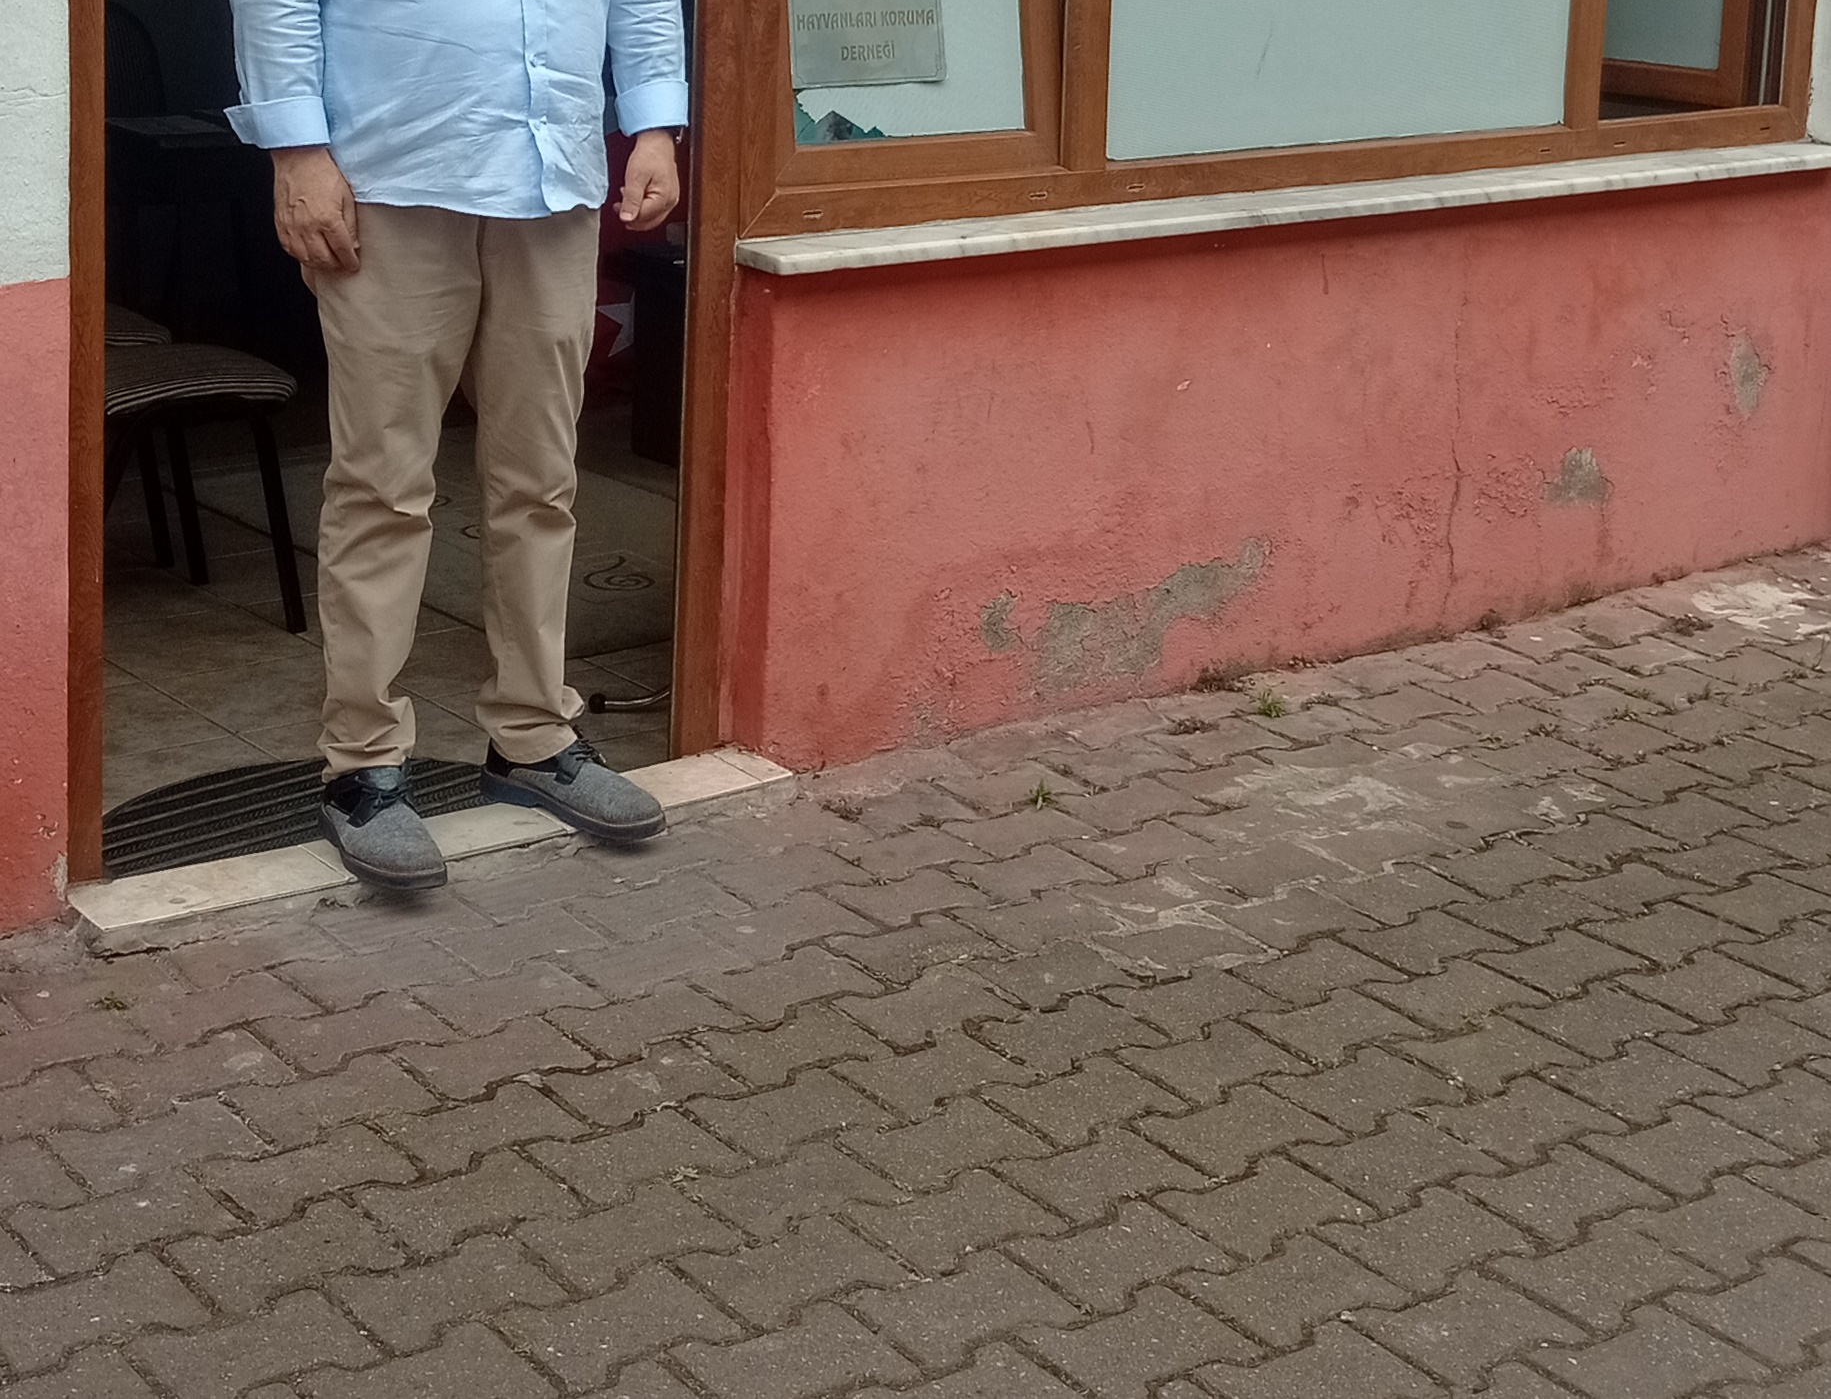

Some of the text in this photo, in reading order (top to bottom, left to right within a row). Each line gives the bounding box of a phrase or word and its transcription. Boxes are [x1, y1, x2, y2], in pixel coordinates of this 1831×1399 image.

[797, 9, 934, 31] HAYVANLARI KORUMA
[841, 41, 895, 61] DERNEĞİ
